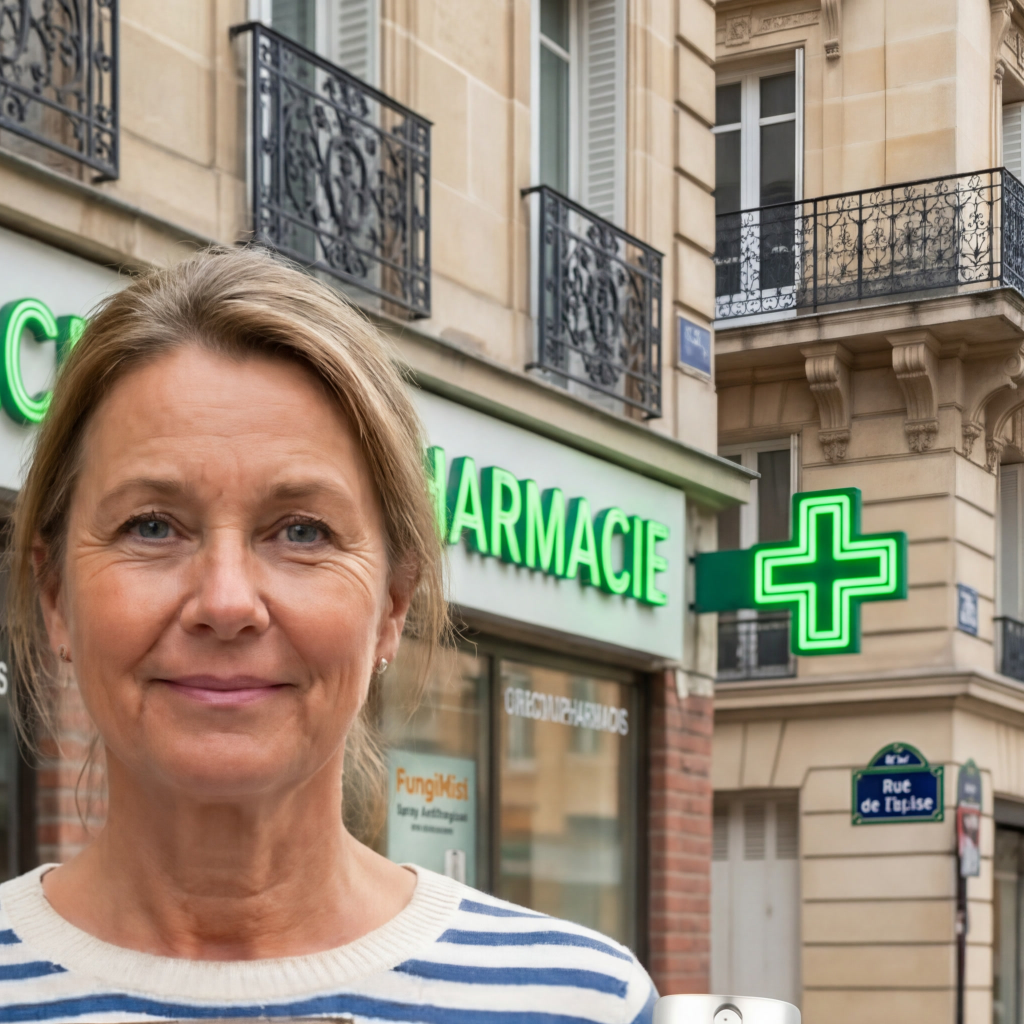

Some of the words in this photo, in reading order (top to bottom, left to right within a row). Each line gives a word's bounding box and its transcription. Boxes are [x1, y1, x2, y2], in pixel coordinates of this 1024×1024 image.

[427, 446, 670, 607] HARMACIE
[882, 778, 912, 794] Rue
[860, 798, 880, 813] de
